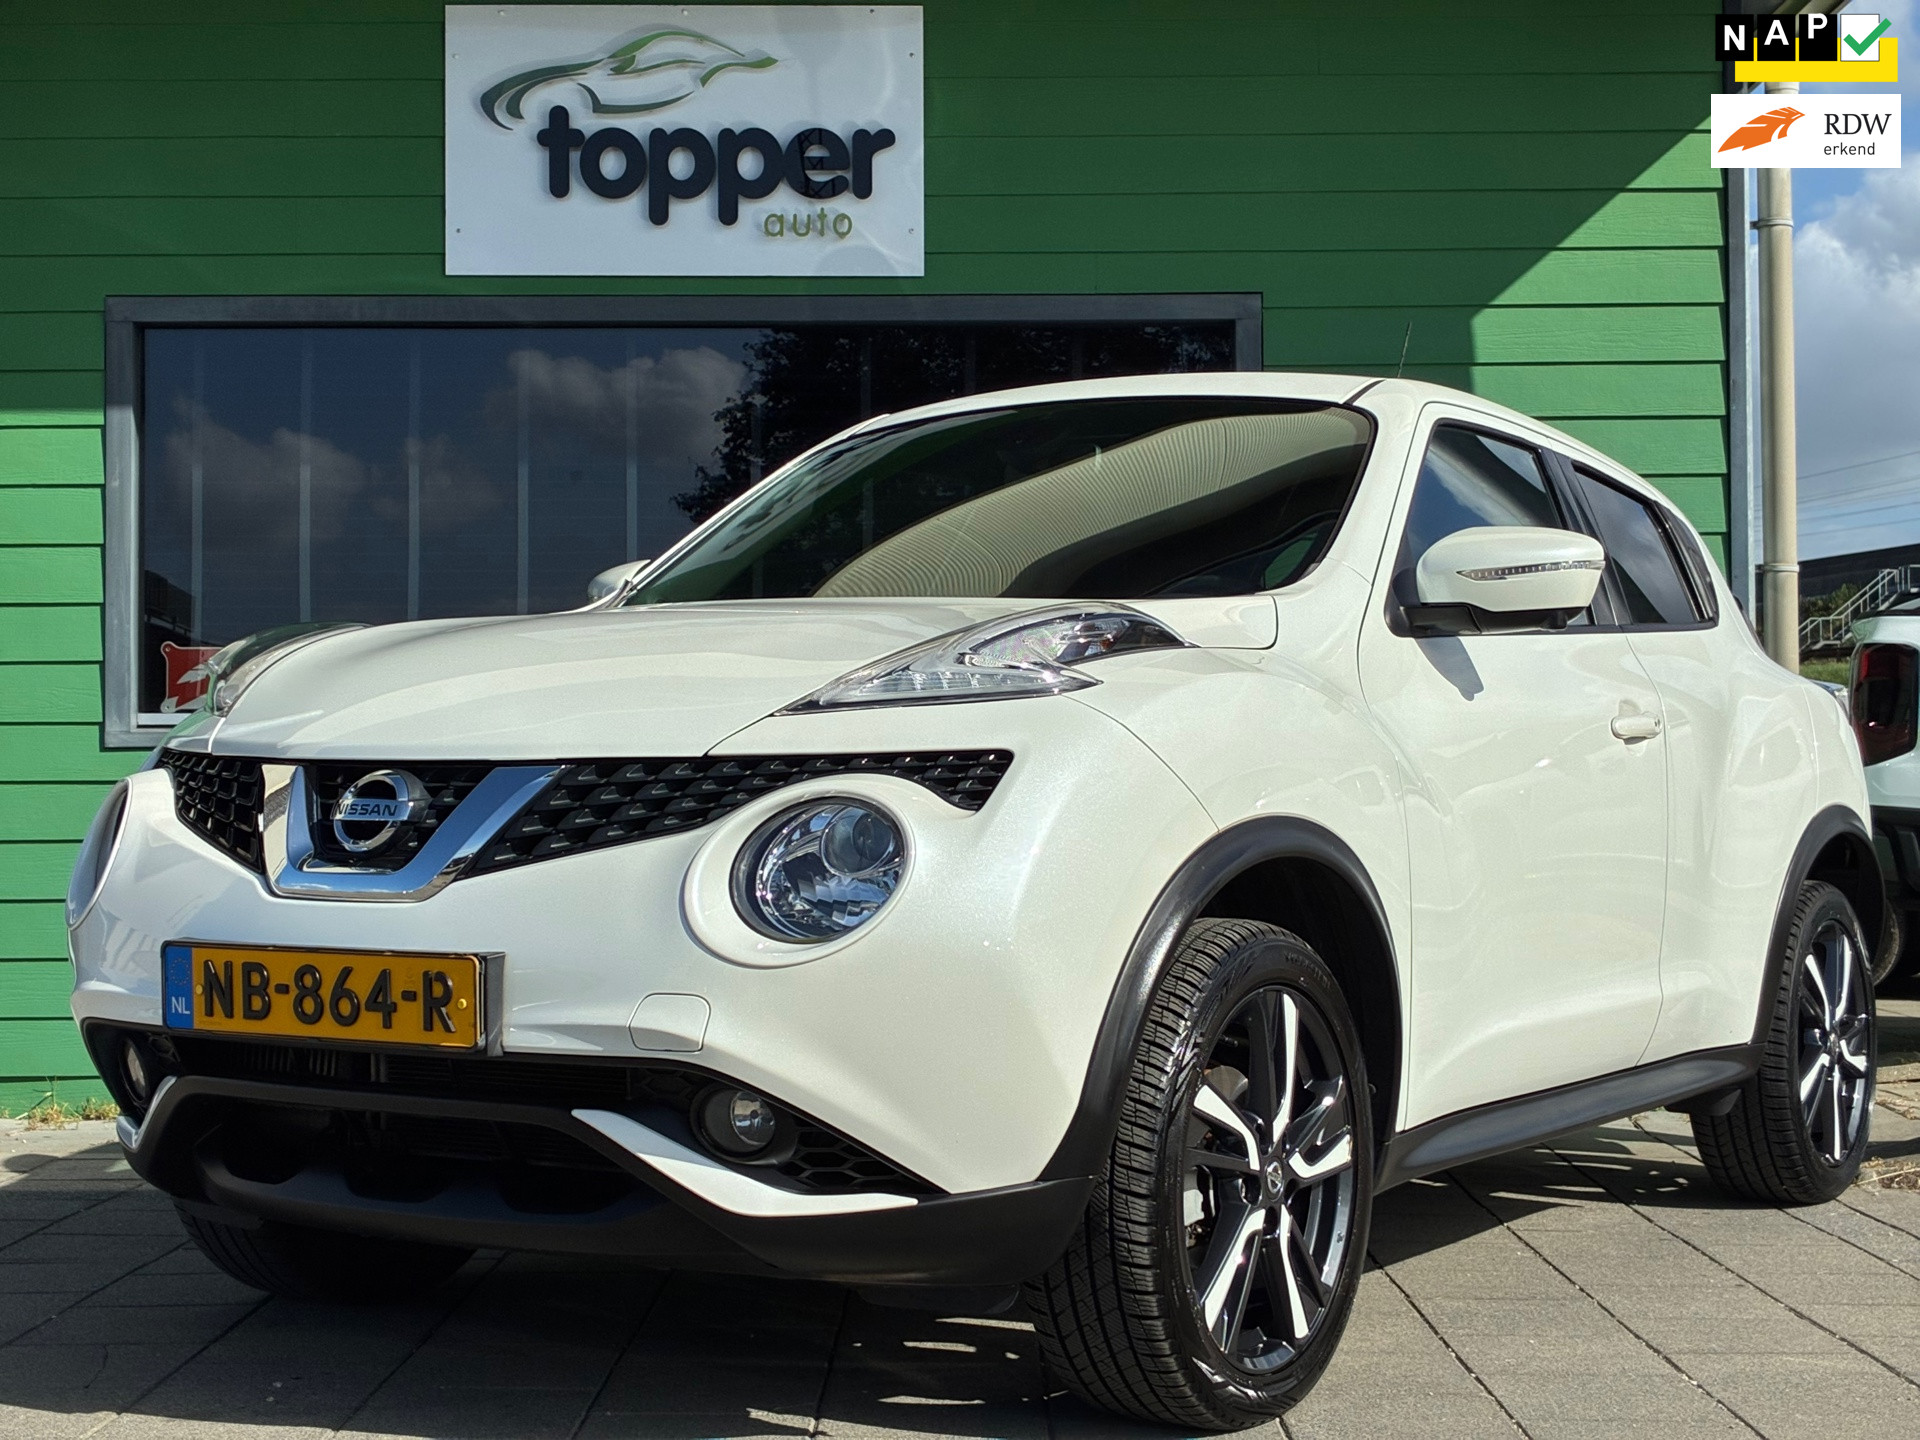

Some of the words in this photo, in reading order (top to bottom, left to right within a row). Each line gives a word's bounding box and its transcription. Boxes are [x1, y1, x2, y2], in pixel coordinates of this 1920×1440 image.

[536, 105, 897, 226] topper
[763, 207, 853, 239] auto
[337, 803, 398, 817] NISSAN
[171, 996, 191, 1016] NL
[203, 959, 457, 1033] NB-864-R
